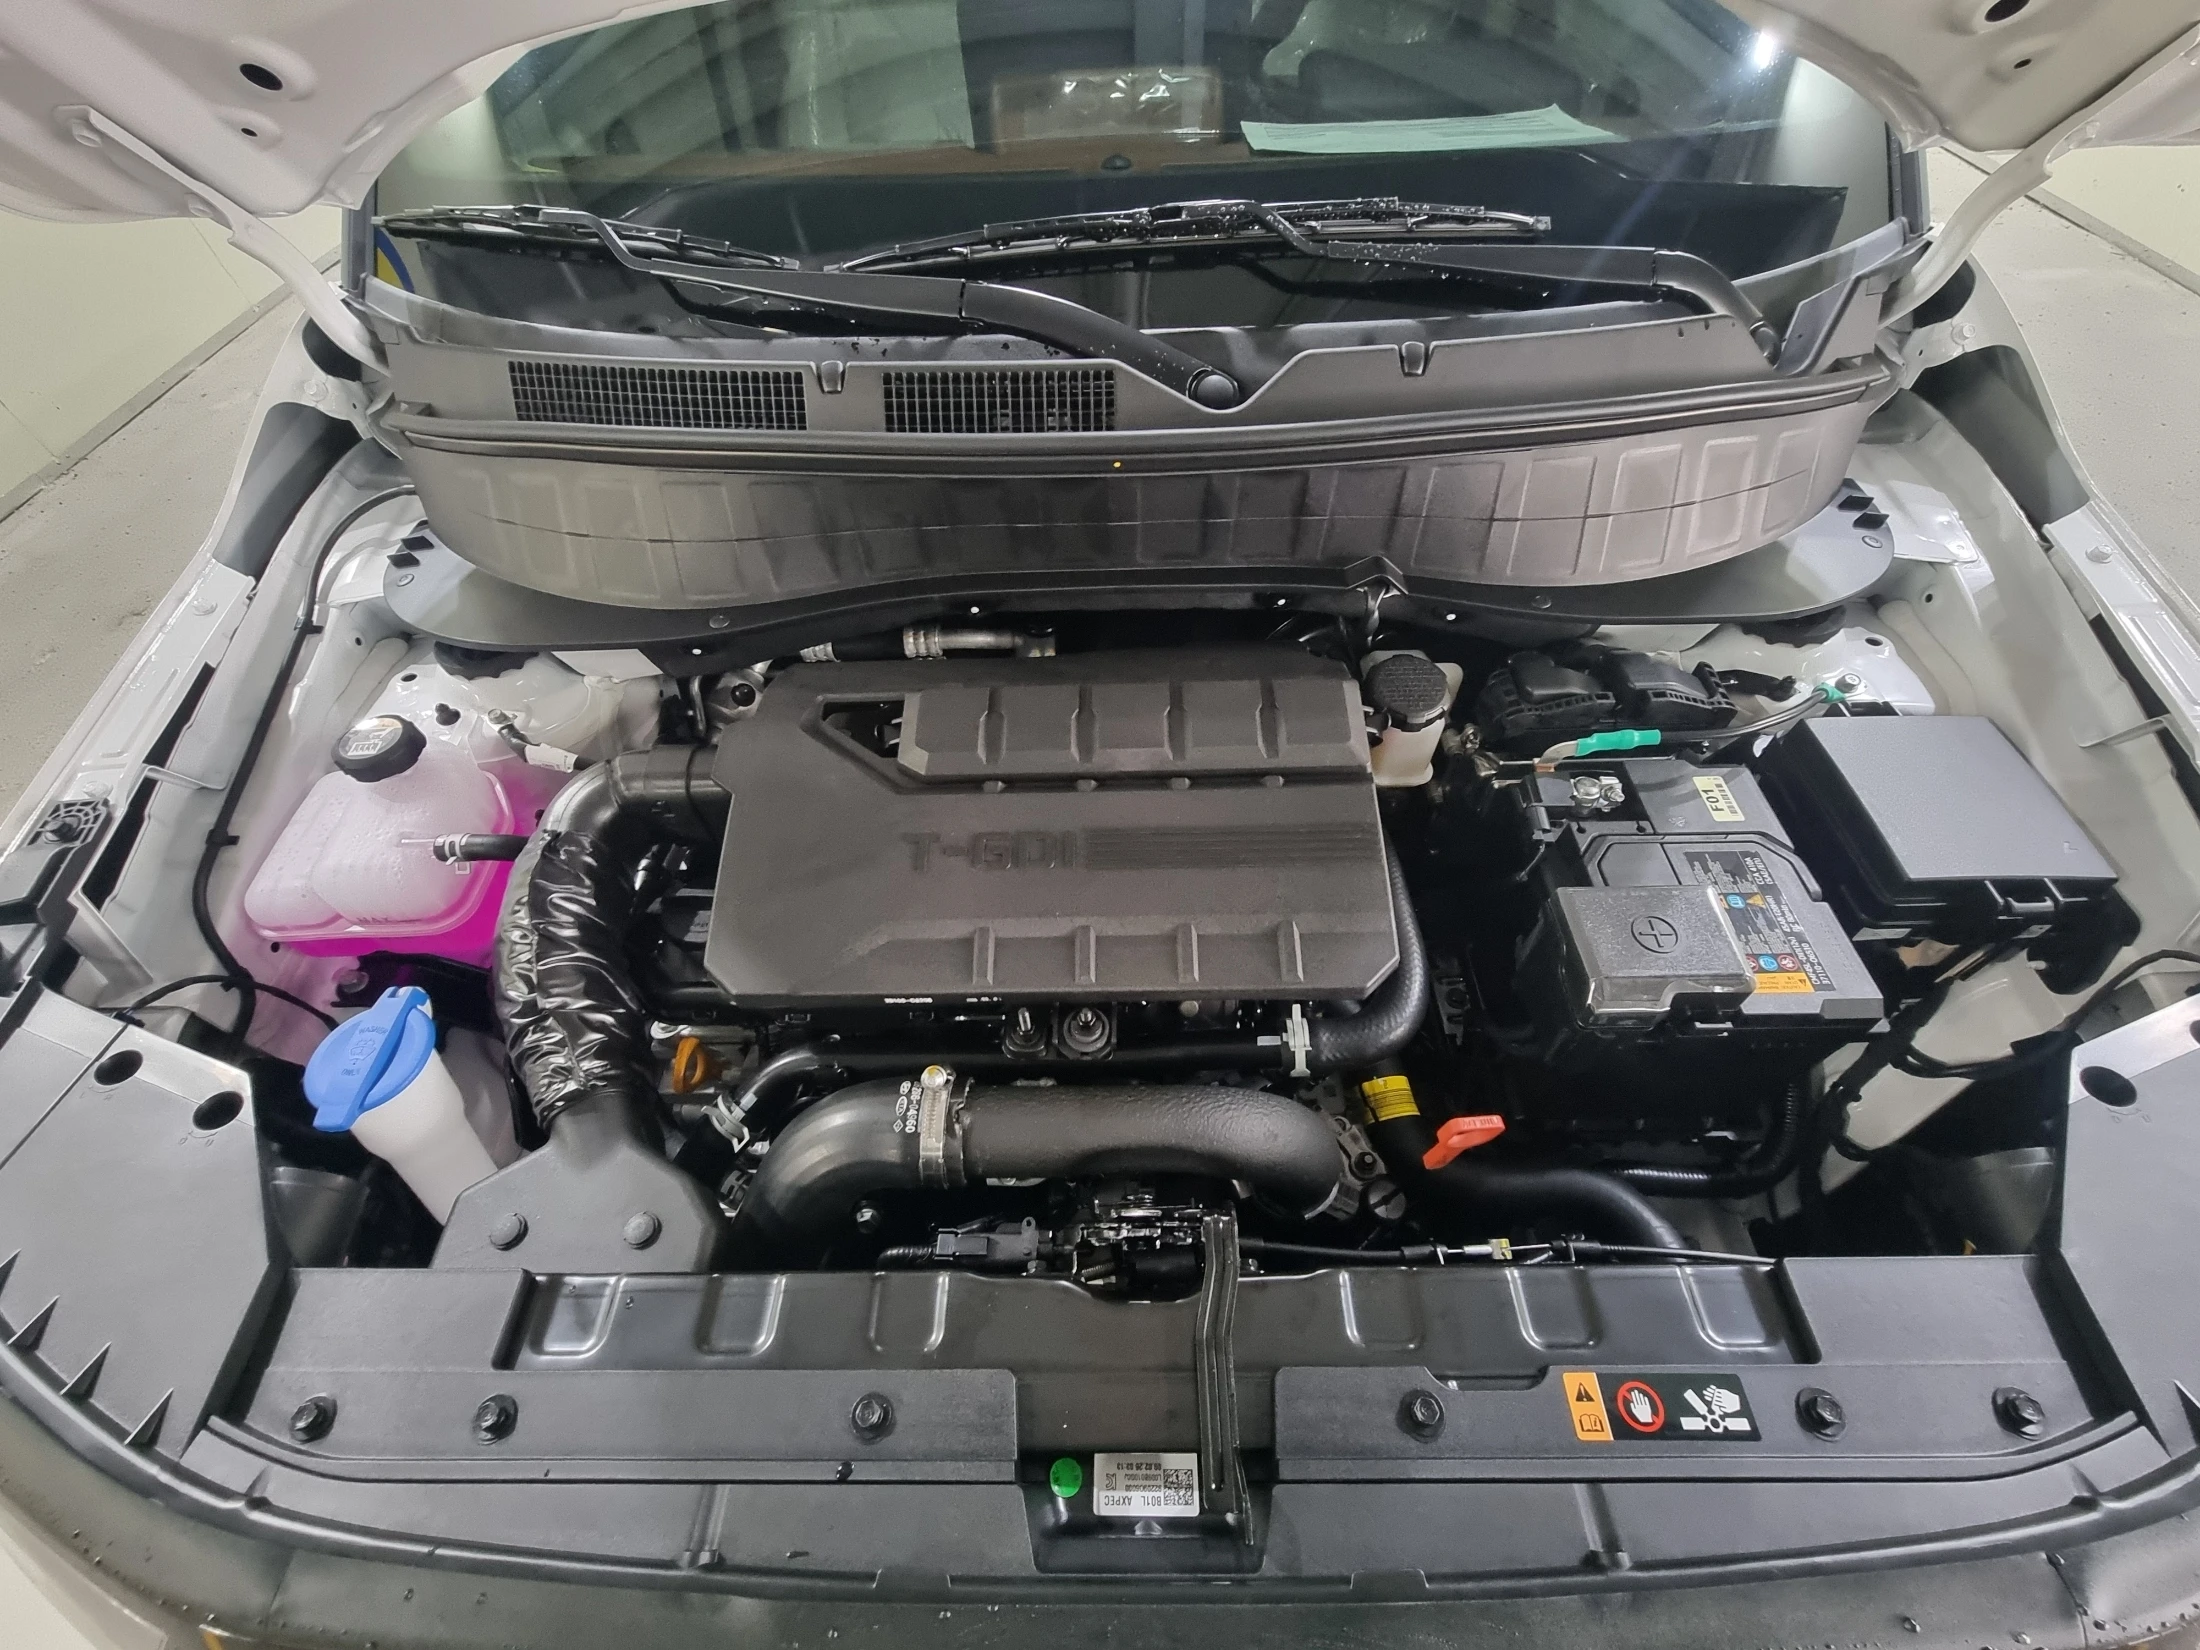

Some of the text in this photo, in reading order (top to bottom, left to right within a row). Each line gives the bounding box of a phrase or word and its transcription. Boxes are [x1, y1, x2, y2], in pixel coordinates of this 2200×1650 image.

[1701, 789, 1725, 811] F01
[900, 831, 1077, 873] T-GDI
[1104, 1495, 1162, 1507] B01L AXPEC
